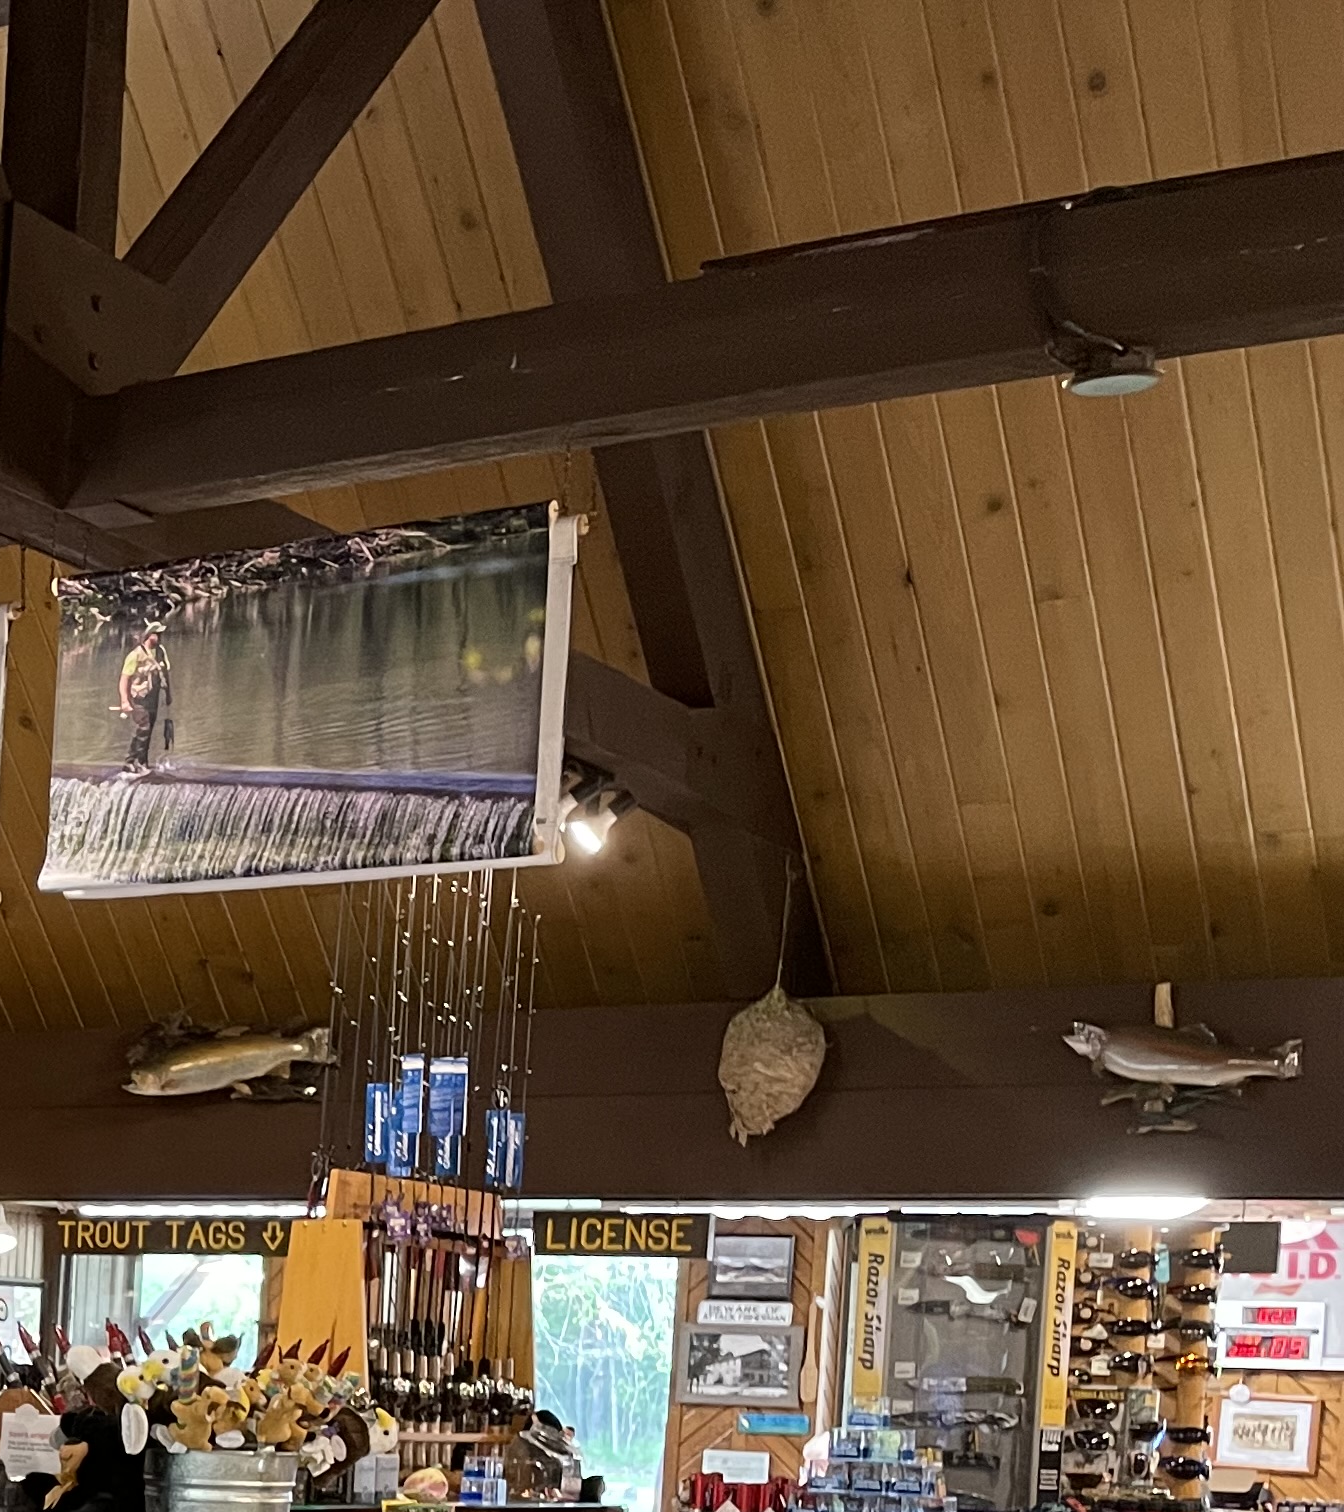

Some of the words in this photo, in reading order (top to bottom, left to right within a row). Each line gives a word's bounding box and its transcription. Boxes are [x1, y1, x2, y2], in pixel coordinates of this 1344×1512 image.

[57, 1219, 152, 1249] TROUT
[164, 1219, 246, 1250] TAGS
[545, 1216, 695, 1252] LICENSE
[865, 1252, 885, 1301] Razor
[1056, 1257, 1071, 1311] Razor
[858, 1307, 882, 1371] Sharp
[1048, 1318, 1068, 1378] Sharp
